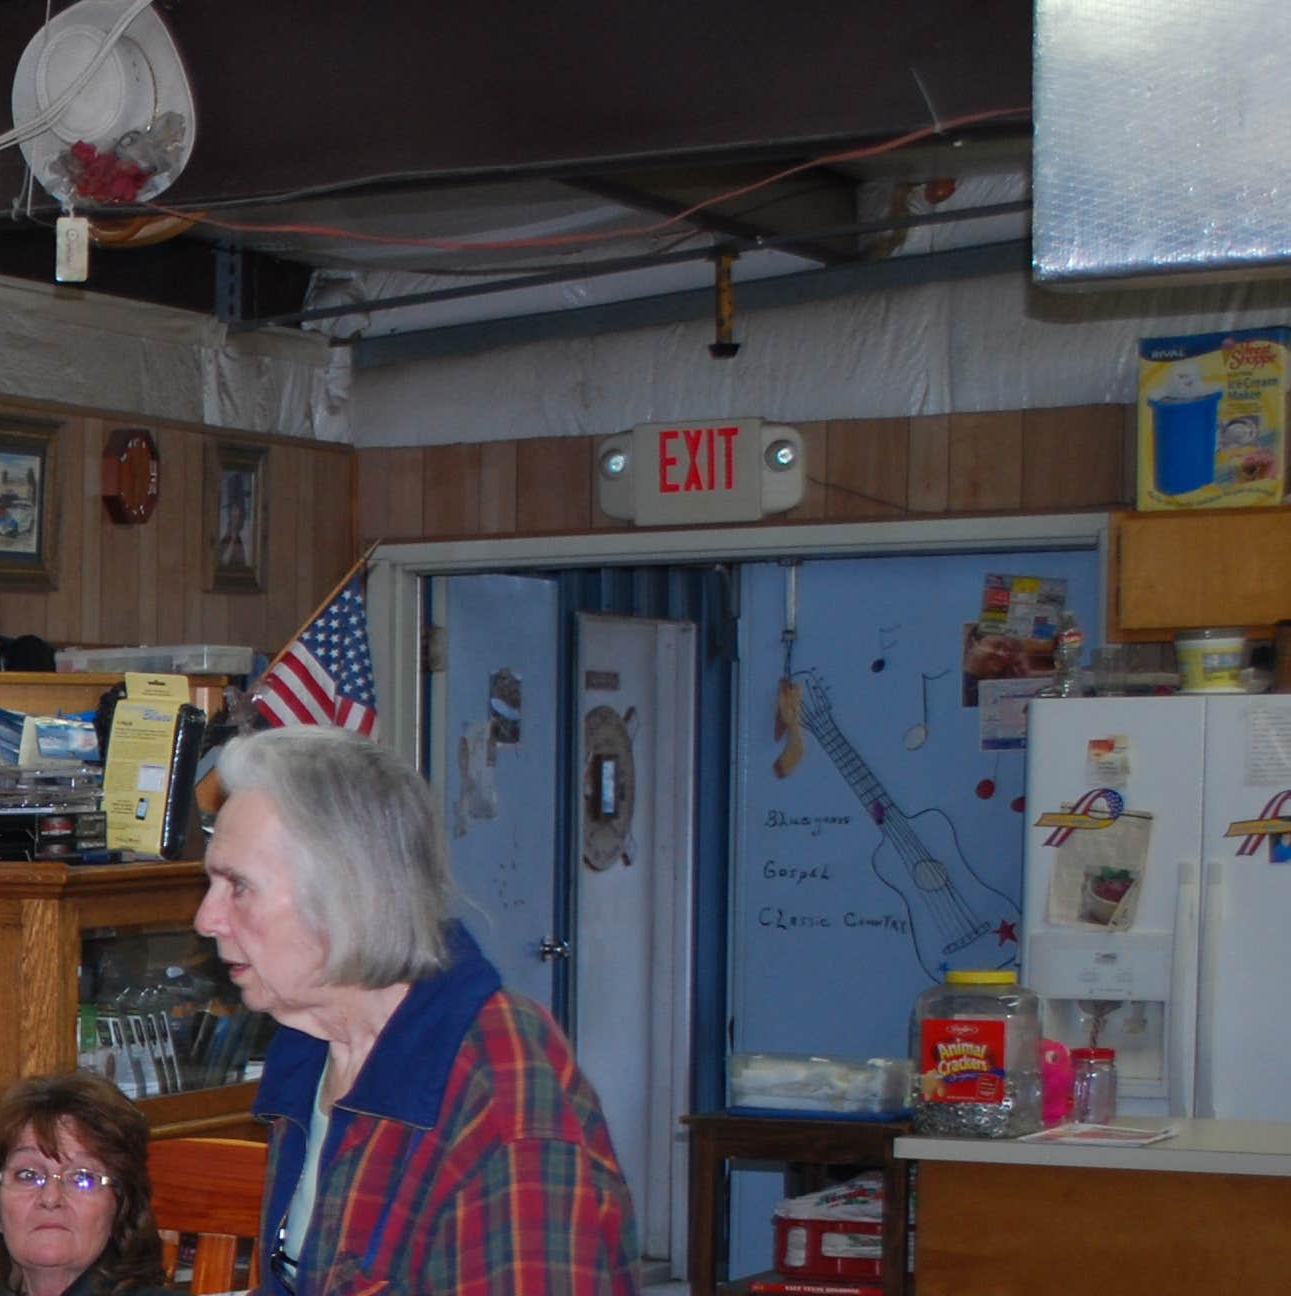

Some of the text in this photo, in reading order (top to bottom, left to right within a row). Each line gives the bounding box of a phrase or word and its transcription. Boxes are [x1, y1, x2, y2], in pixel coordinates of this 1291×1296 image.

[1150, 349, 1185, 360] RIVAL
[659, 426, 739, 493] EXIT
[937, 1037, 988, 1061] Animal
[937, 1055, 988, 1076] Crackers
